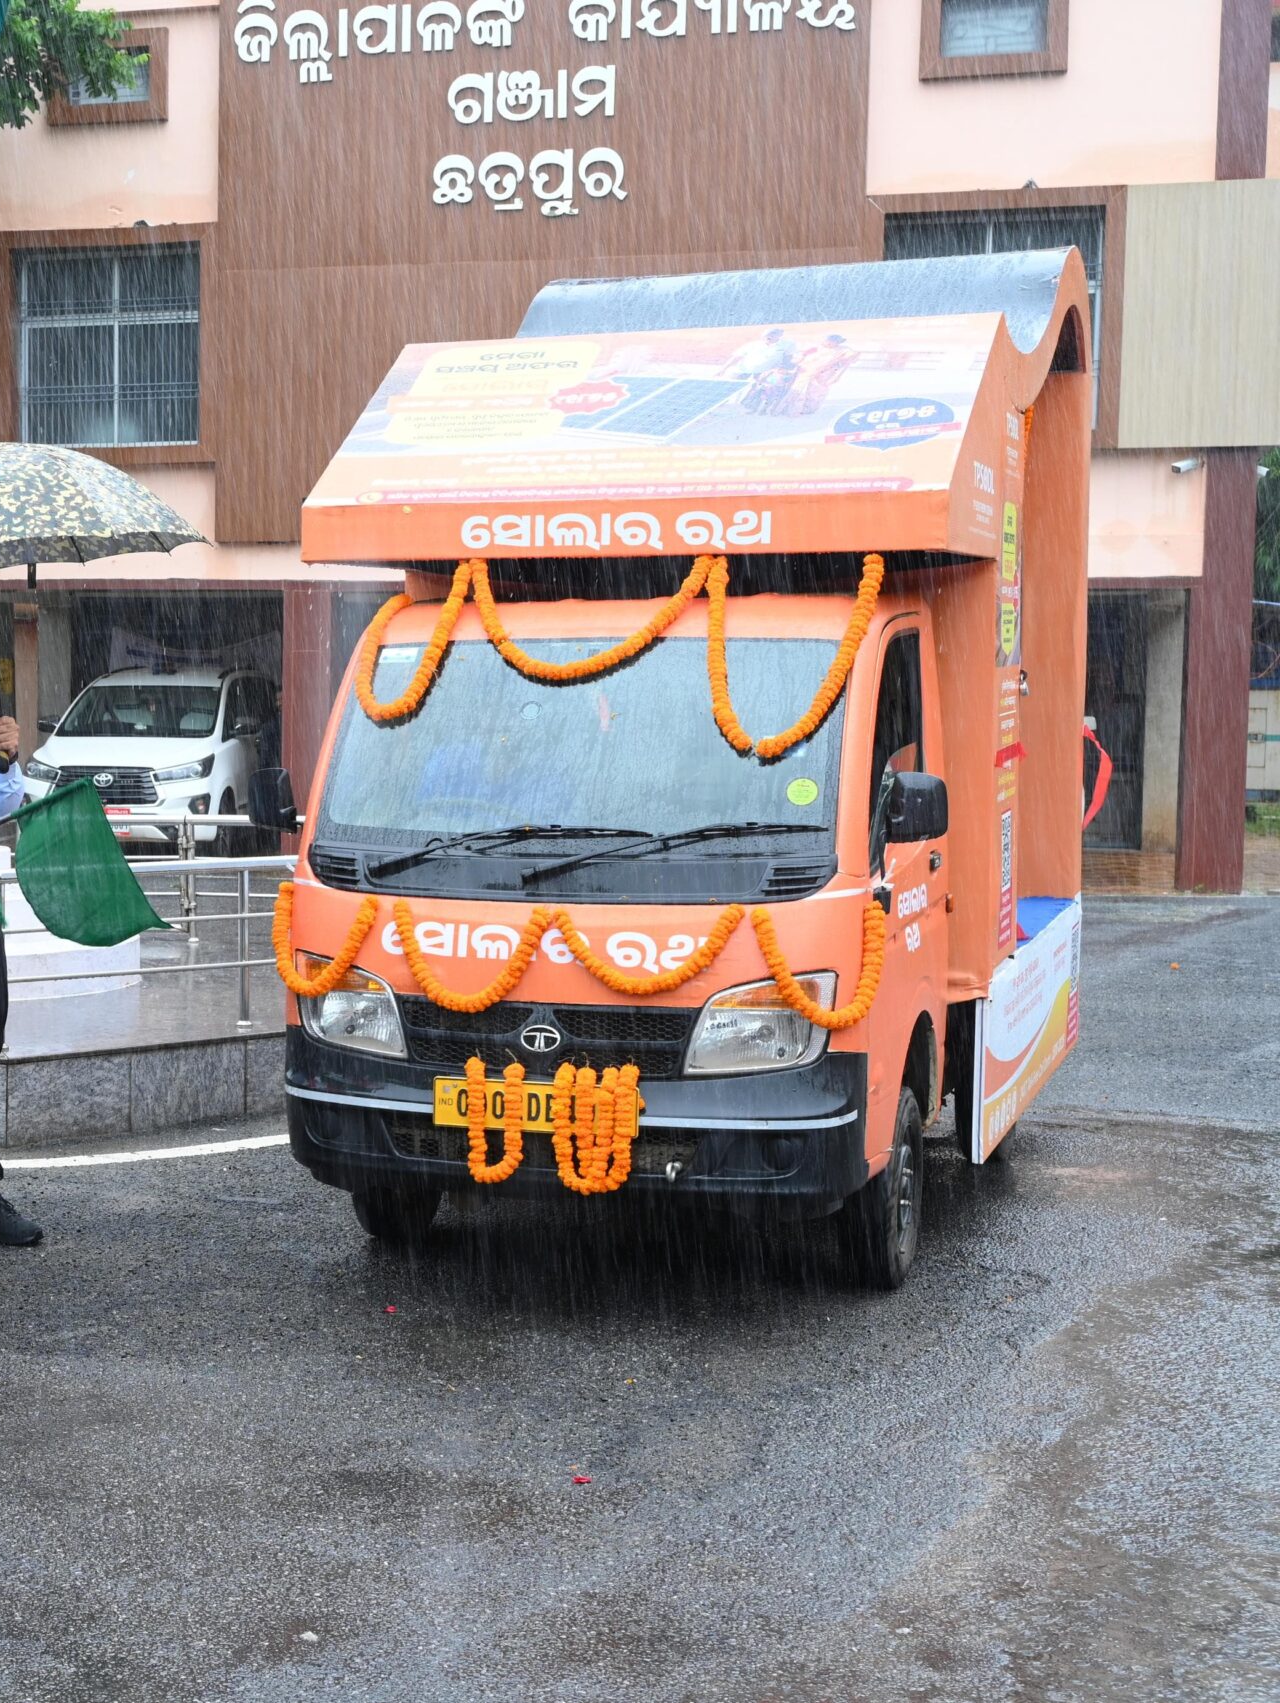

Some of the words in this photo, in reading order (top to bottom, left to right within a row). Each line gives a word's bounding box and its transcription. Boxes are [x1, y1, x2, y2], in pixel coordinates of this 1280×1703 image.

[446, 64, 617, 125] ଗଞ୍ଜାମ
[432, 146, 627, 217] ଛତ୍ରପୁର
[461, 509, 664, 549] ସୋଲାର
[678, 508, 772, 547] ରଥ
[381, 919, 591, 968] ସୋଲର
[438, 1098, 453, 1106] IND
